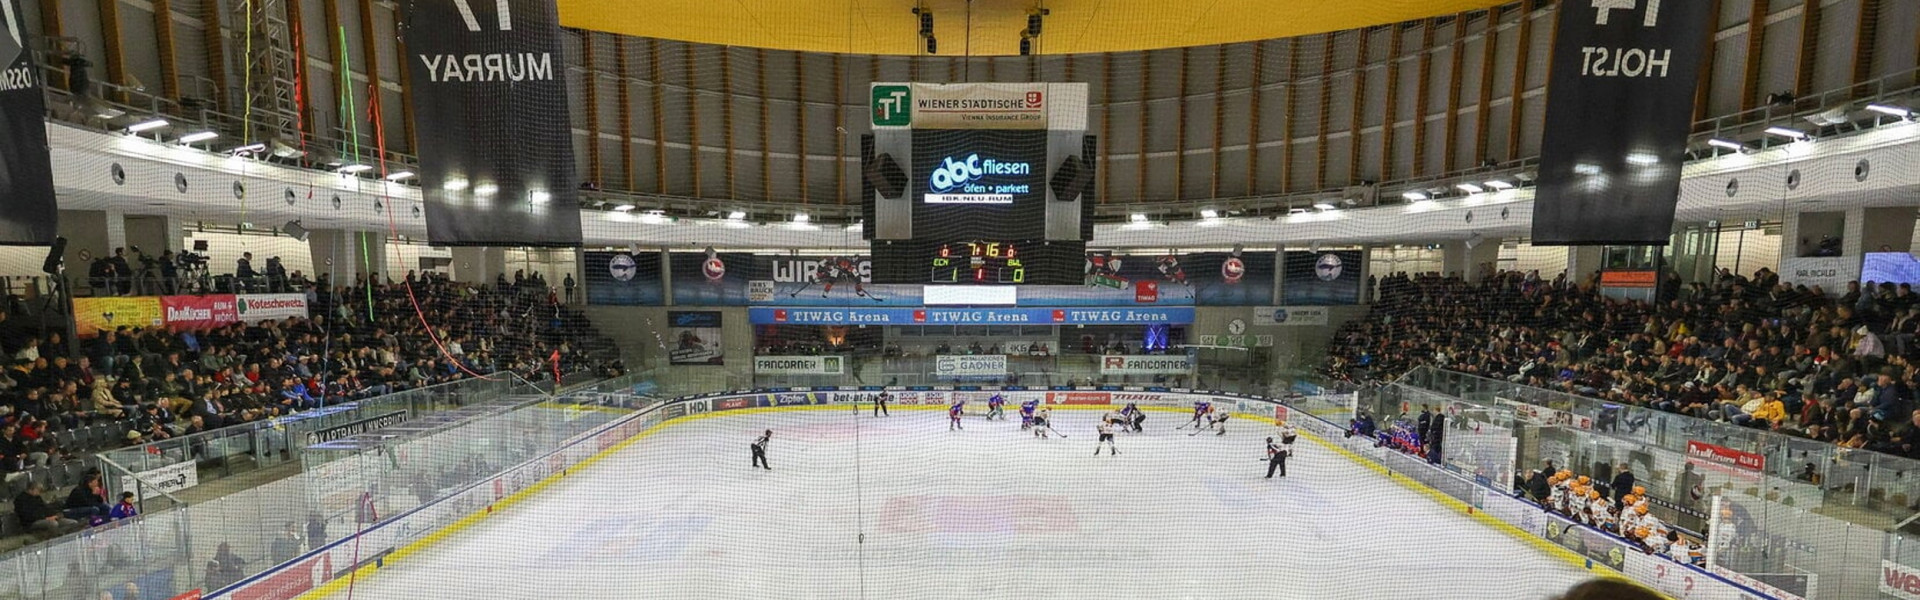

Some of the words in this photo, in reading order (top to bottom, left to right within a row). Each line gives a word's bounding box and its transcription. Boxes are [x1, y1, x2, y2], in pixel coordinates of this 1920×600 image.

[919, 99, 959, 109] WIENER
[961, 98, 1024, 109] STÄDTISCHE
[931, 153, 983, 190] abc
[982, 159, 1030, 175] fliesen
[964, 183, 986, 193] öfen
[995, 183, 1029, 195] parkett
[793, 311, 843, 322] TIWAG
[849, 311, 890, 322] Arena
[932, 311, 982, 322] TIWAG
[986, 311, 1029, 322] Arena
[1071, 311, 1121, 321] TIWAG
[1126, 311, 1168, 321] Arena
[758, 359, 816, 370] FANCORNER
[961, 361, 1004, 370] GADNER
[1127, 360, 1187, 370] FANCORNER
